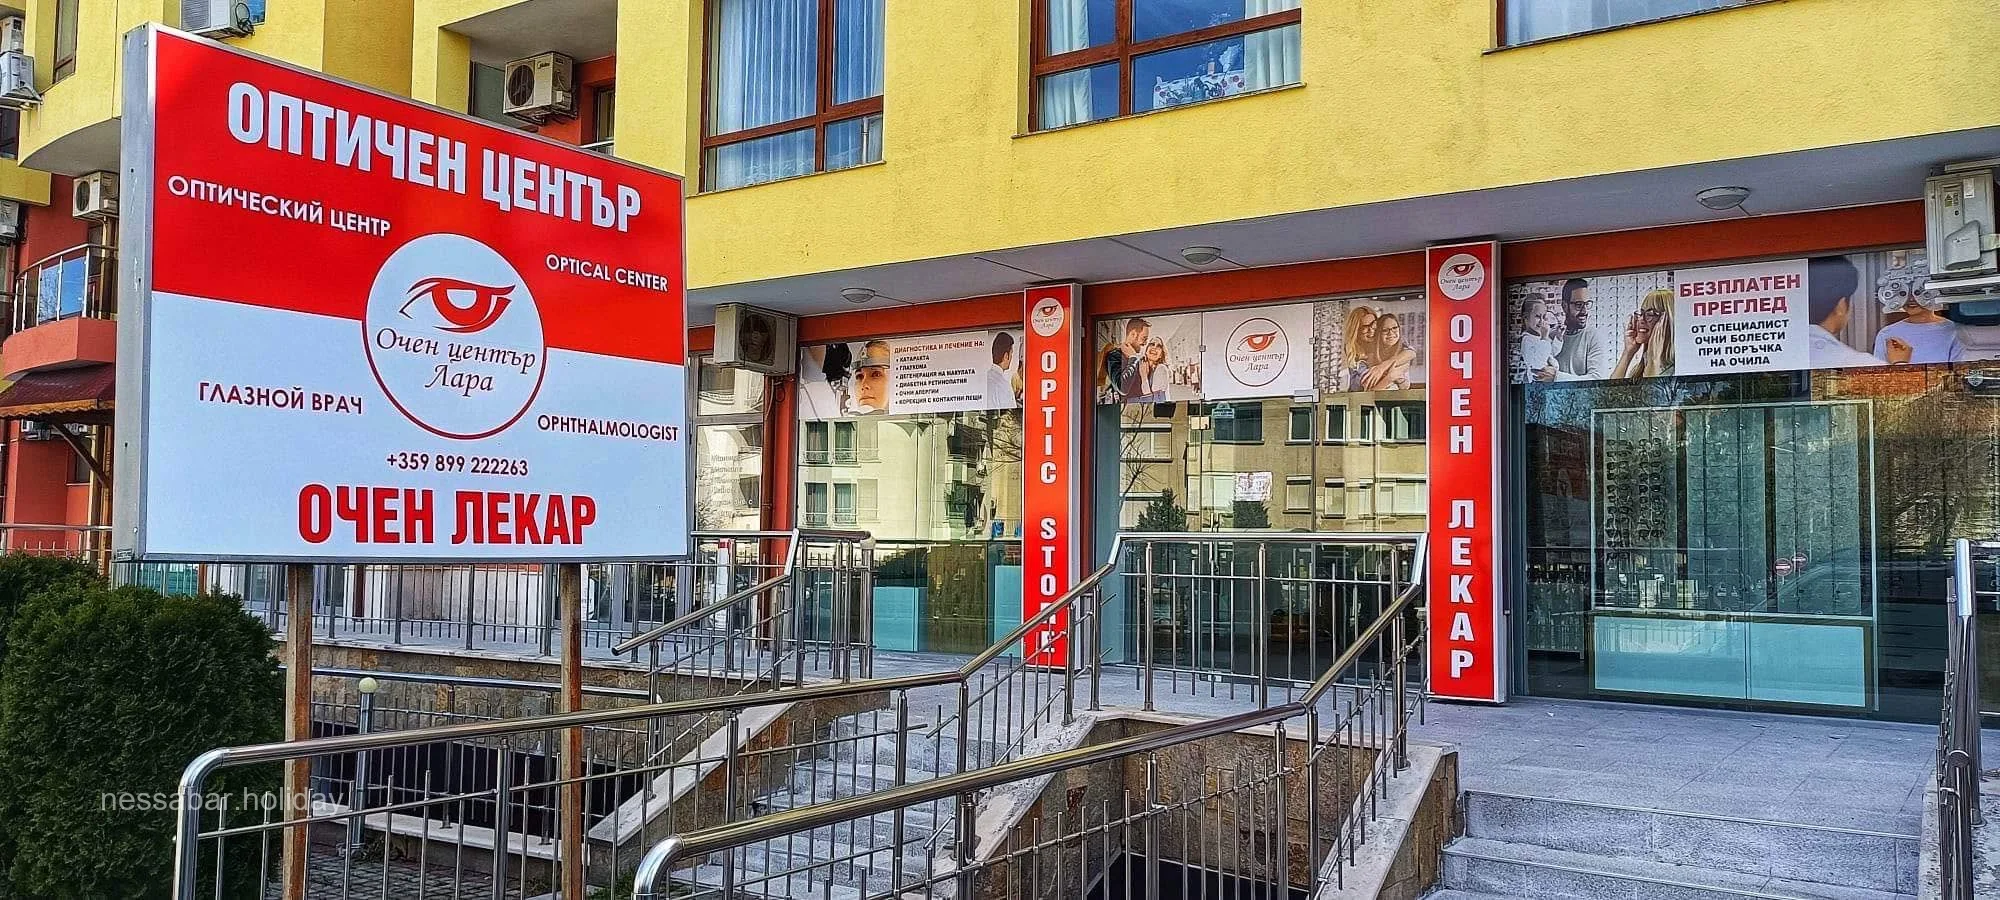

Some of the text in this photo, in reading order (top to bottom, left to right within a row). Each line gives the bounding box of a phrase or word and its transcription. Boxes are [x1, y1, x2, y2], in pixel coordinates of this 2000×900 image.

[228, 82, 641, 232] ОПТИЧЕН ЦЕНТЪР
[168, 175, 391, 237] ОПТИЧЕСКИЙ ЦЕНТР
[546, 254, 668, 292] OPTICAL CENTER
[1680, 274, 1800, 297] БЕЗПЛАТЕН
[1693, 296, 1787, 316] ПРЕГЛЕД
[1691, 319, 1789, 333] ОТ СПЕЦИАЛИСТ
[1695, 332, 1785, 344] ОЧНИ БОЛЕСТИ
[377, 328, 536, 375] Очен център
[894, 345, 937, 354] ДИАГНОСТИКА
[944, 341, 973, 350] ЛЕЧЕНИЕ
[1229, 352, 1285, 362] Очен център
[1699, 344, 1782, 356] ПРИ ПОРЪЧКА
[1244, 362, 1269, 372] Лара
[1710, 356, 1770, 367] НА ОЧИЛА
[424, 364, 493, 397] Лара
[199, 382, 362, 414] ГЛАЗНОЙ ВРАЧ
[538, 415, 678, 441] OPHTHALMOLOGIST
[1040, 351, 1057, 484] OPTIC
[386, 453, 529, 476] +359 899 222263
[1448, 314, 1475, 679] ОЧЕН ЛЕКАР
[299, 484, 596, 545] ОЧЕН ЛЕКАР
